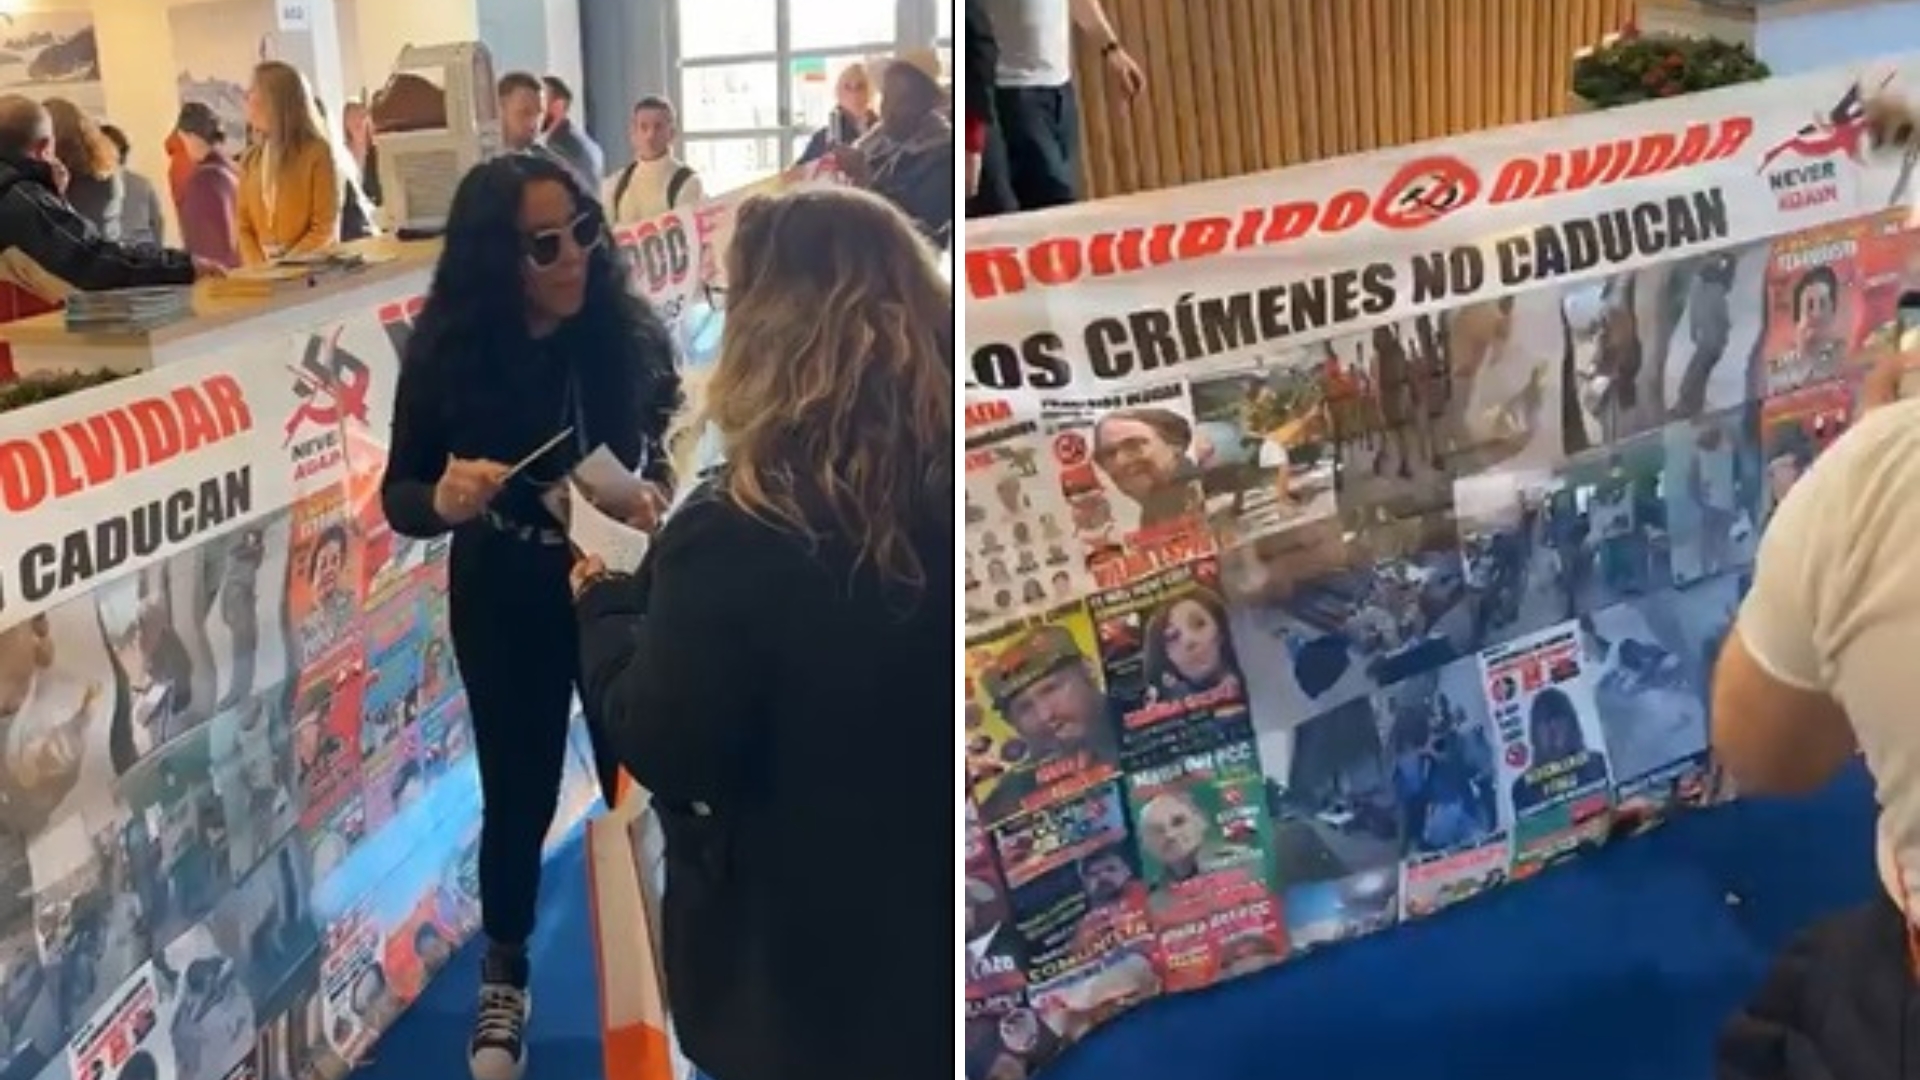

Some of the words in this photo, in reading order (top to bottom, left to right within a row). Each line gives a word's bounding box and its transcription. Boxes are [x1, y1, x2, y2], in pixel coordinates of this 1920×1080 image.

[1488, 116, 1753, 204] OLVIDAR
[1769, 161, 1836, 190] NEVER
[1779, 186, 1837, 210] AGAIN
[965, 331, 1072, 390] OS
[1084, 262, 1396, 379] CRÍMENES
[1411, 246, 1484, 303] NO
[1496, 187, 1729, 287] CADUCAN
[0, 374, 252, 513] OLVIDAR
[292, 430, 338, 462] NEVE
[19, 465, 251, 602] CADUCAN
